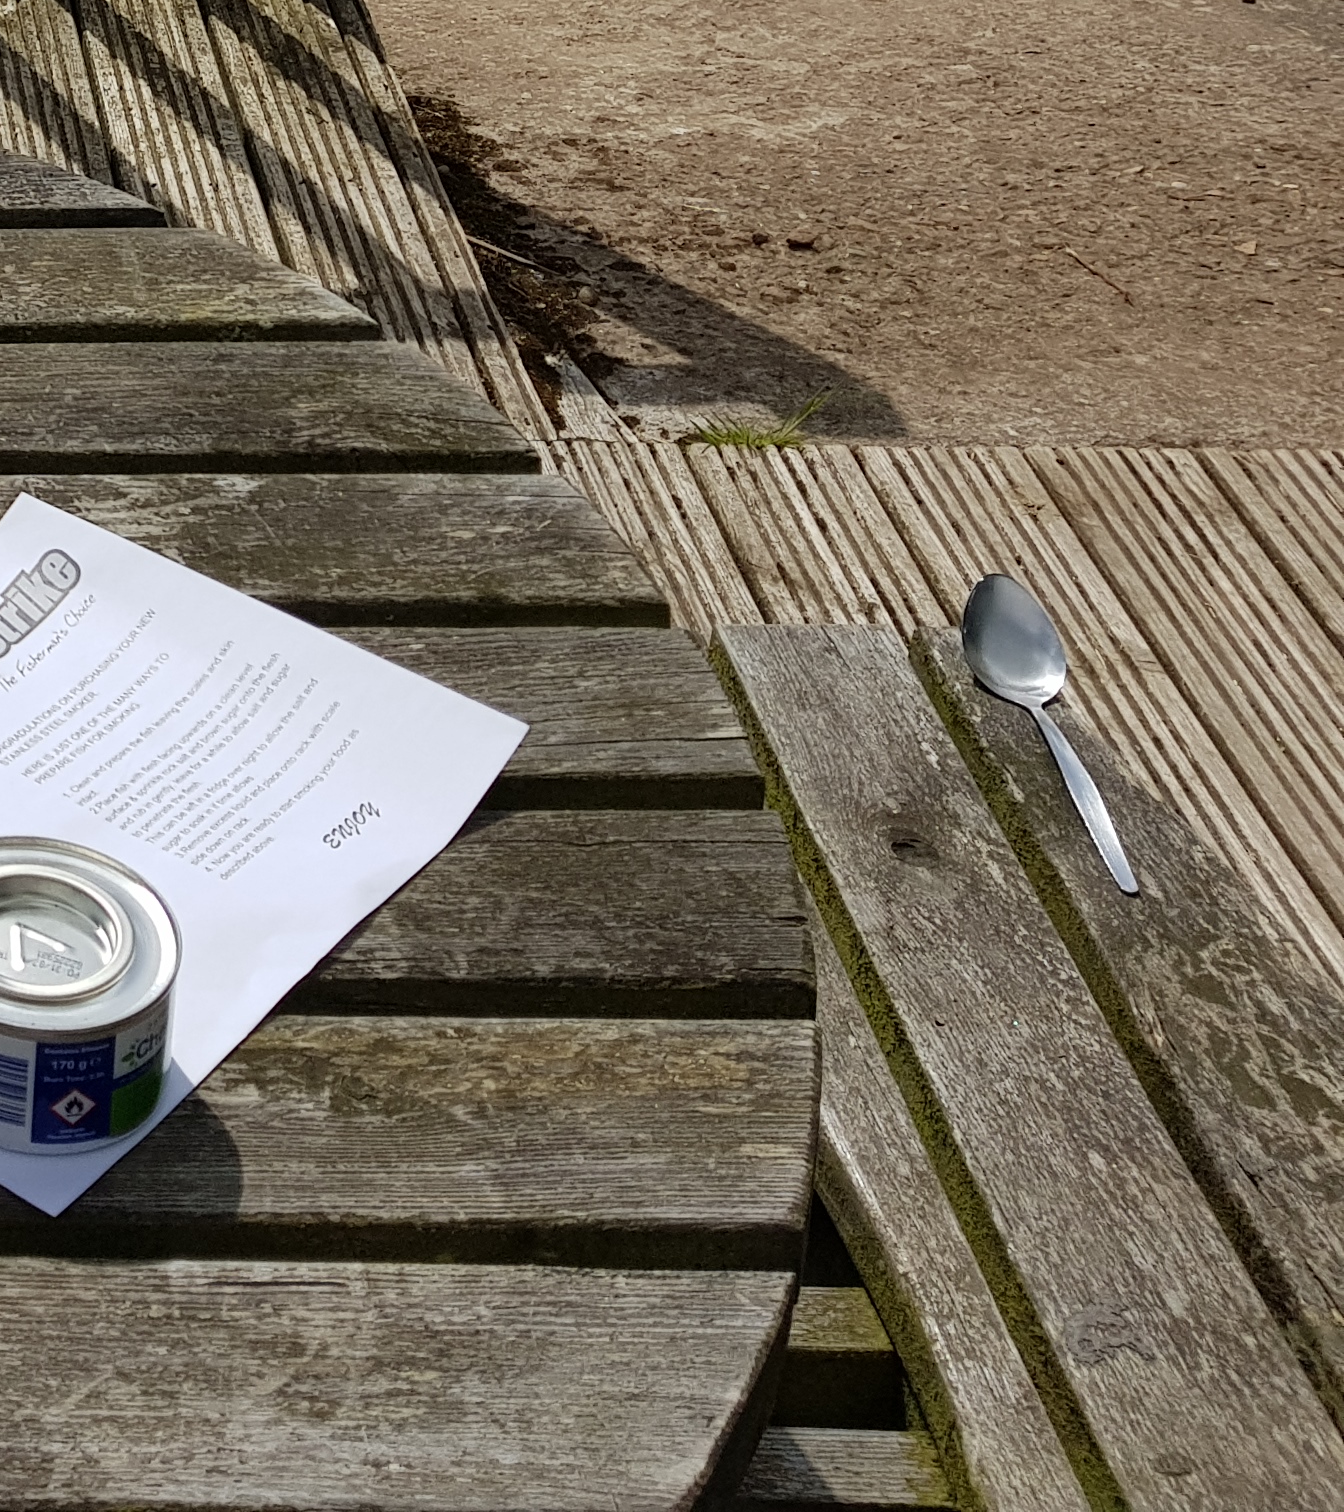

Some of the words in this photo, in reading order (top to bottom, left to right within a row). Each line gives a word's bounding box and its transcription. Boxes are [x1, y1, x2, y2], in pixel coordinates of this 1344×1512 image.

[15, 629, 69, 678] Fisherman's
[63, 594, 96, 628] Choice
[69, 652, 120, 696] PURCHASING
[115, 629, 140, 652] YOUR
[135, 608, 156, 631] NEW
[96, 704, 117, 719] THE
[112, 685, 136, 706] MANY
[133, 664, 159, 687] WAYS
[154, 652, 170, 665] TO
[39, 718, 68, 737] STEEL
[331, 738, 352, 758] food
[322, 801, 381, 849] ENJOY
[51, 1060, 75, 1070] 170
[79, 1061, 86, 1070] g
